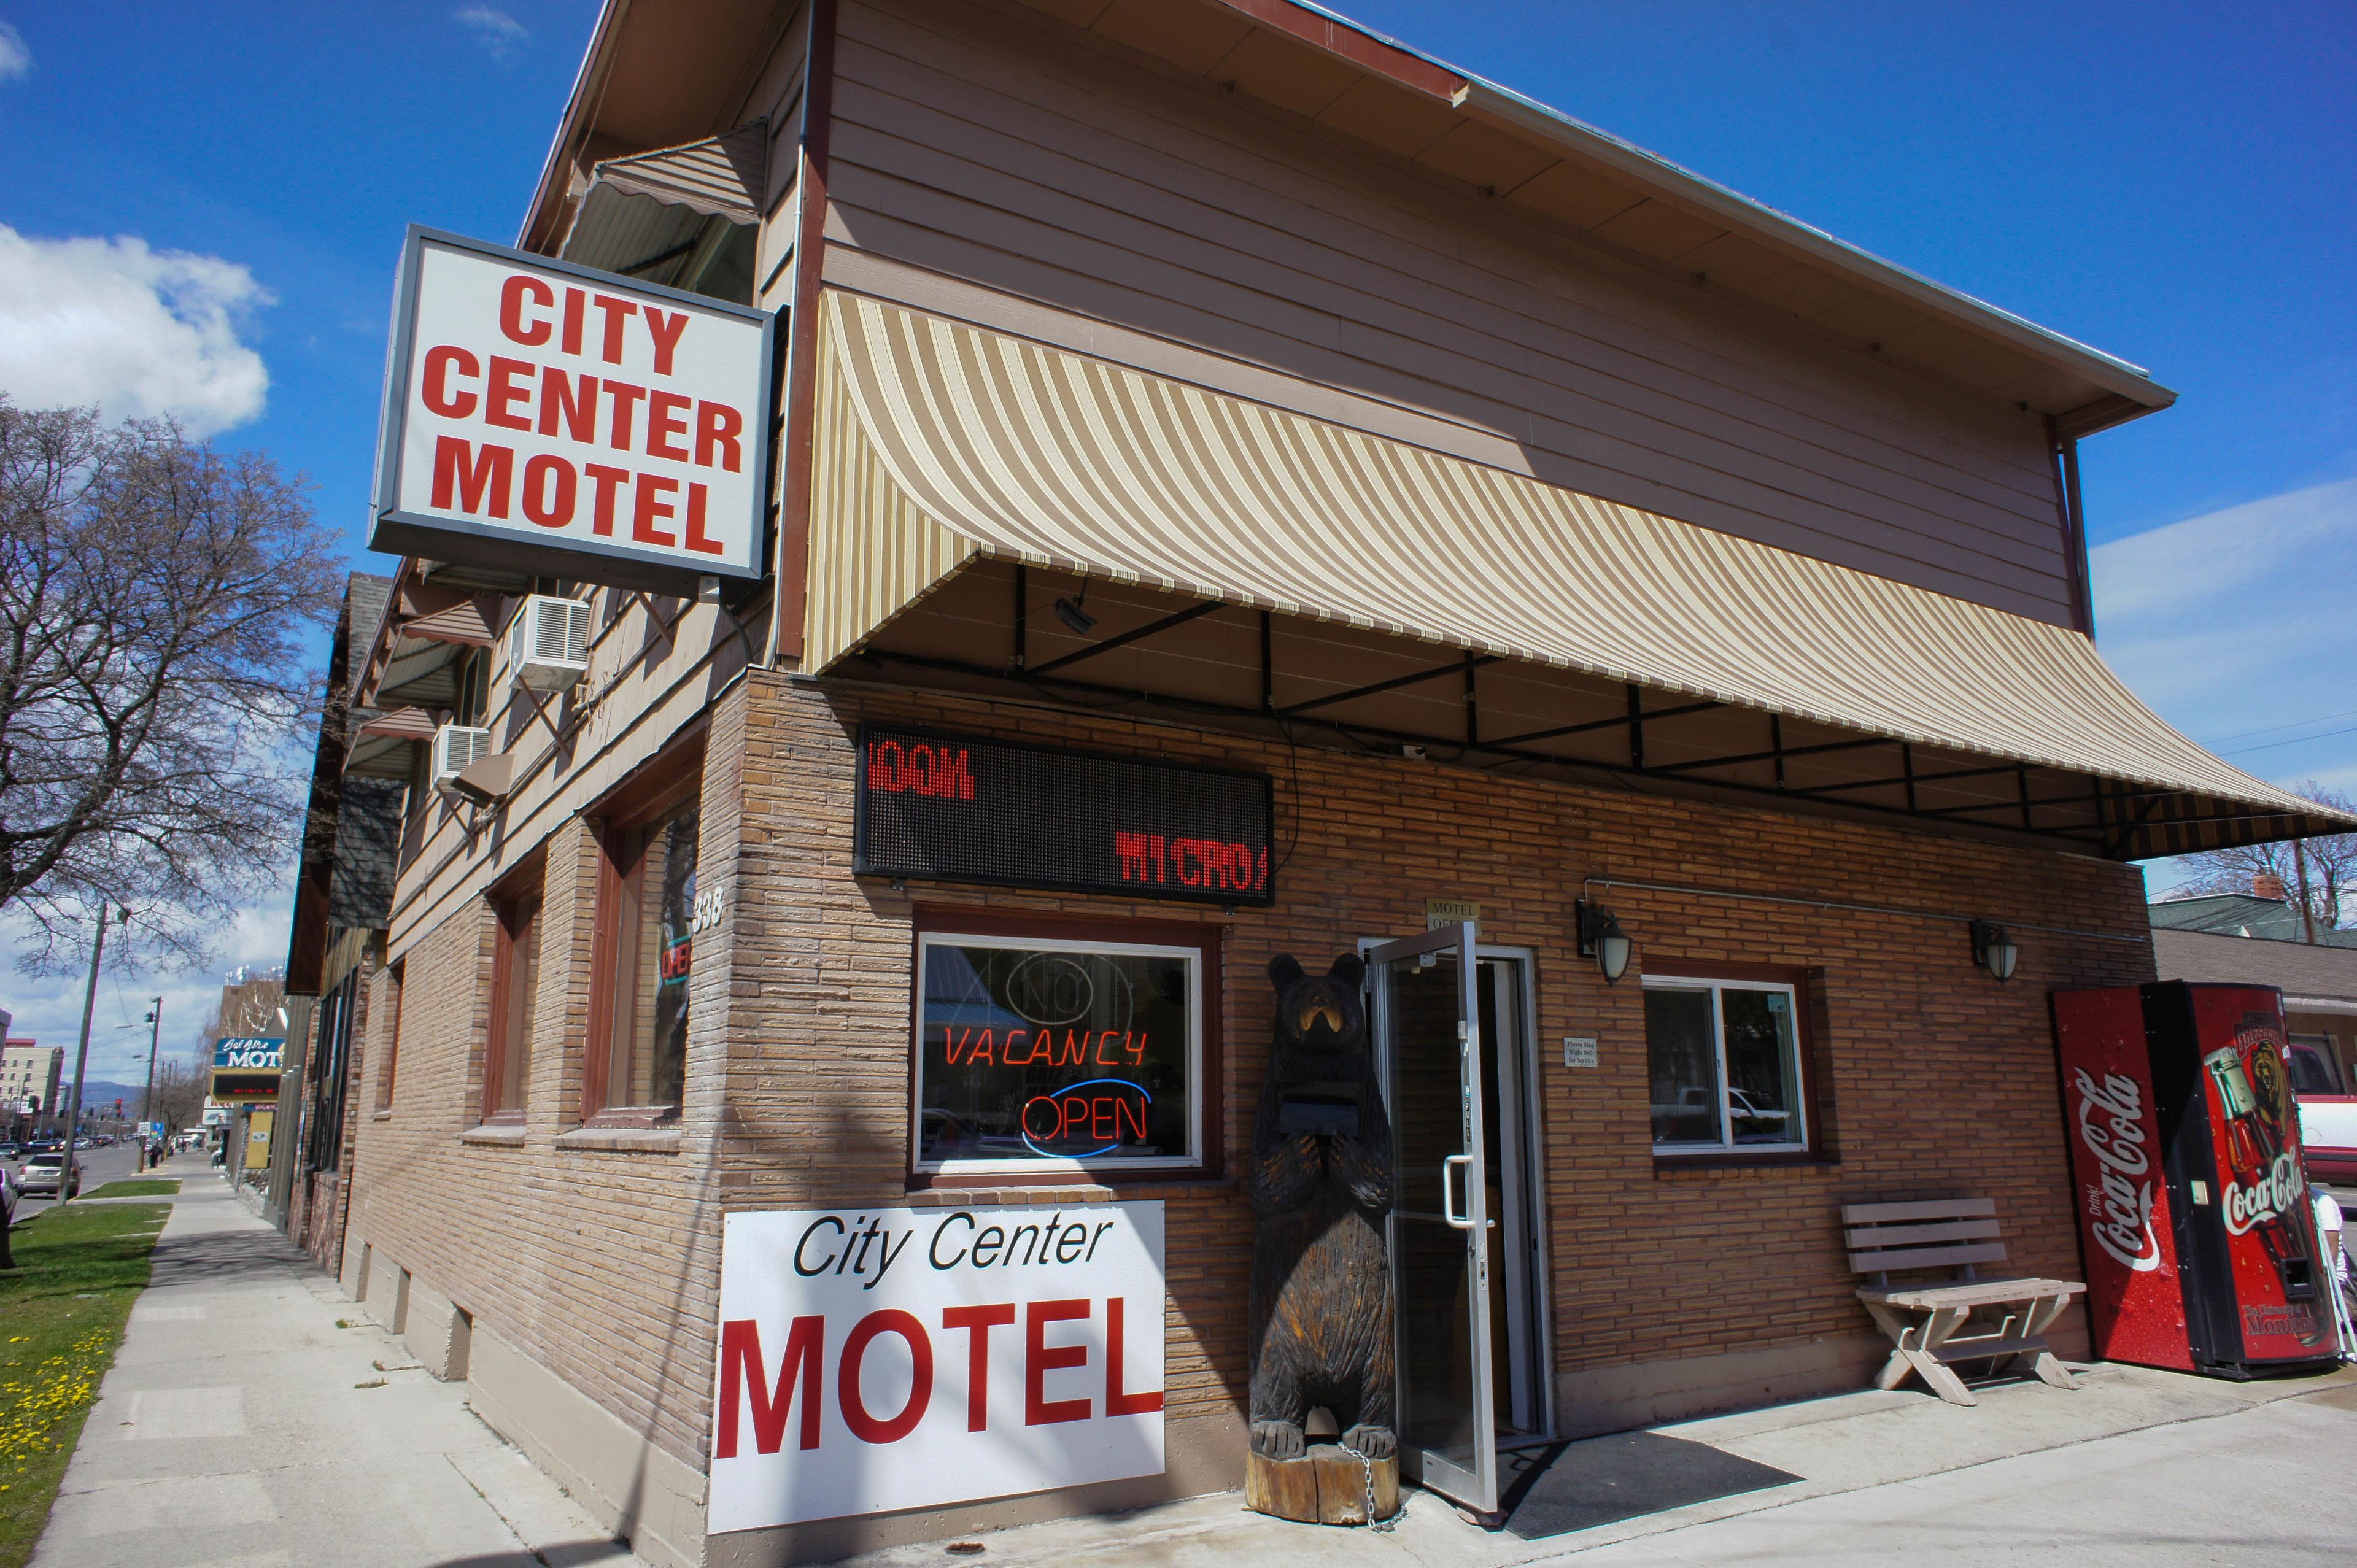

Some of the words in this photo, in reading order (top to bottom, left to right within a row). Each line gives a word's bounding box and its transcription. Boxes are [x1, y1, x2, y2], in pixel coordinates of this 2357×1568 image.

[500, 275, 689, 376] CITY
[422, 345, 742, 473] CENTER
[430, 434, 723, 555] MOTEL
[692, 886, 724, 933] 338
[1433, 903, 1474, 916] MOTEL
[662, 943, 691, 979] OPE
[227, 1051, 282, 1067] MOT
[945, 1028, 1147, 1065] VACANCY
[1023, 1096, 1147, 1140] OPEN
[2074, 1067, 2159, 1272] Coca-Cola
[2086, 1184, 2102, 1216] Drink!
[2223, 1146, 2304, 1237] Coca-Cola
[794, 1215, 913, 1289] City
[929, 1211, 1114, 1270] Center
[716, 1297, 1164, 1459] MOTEL
